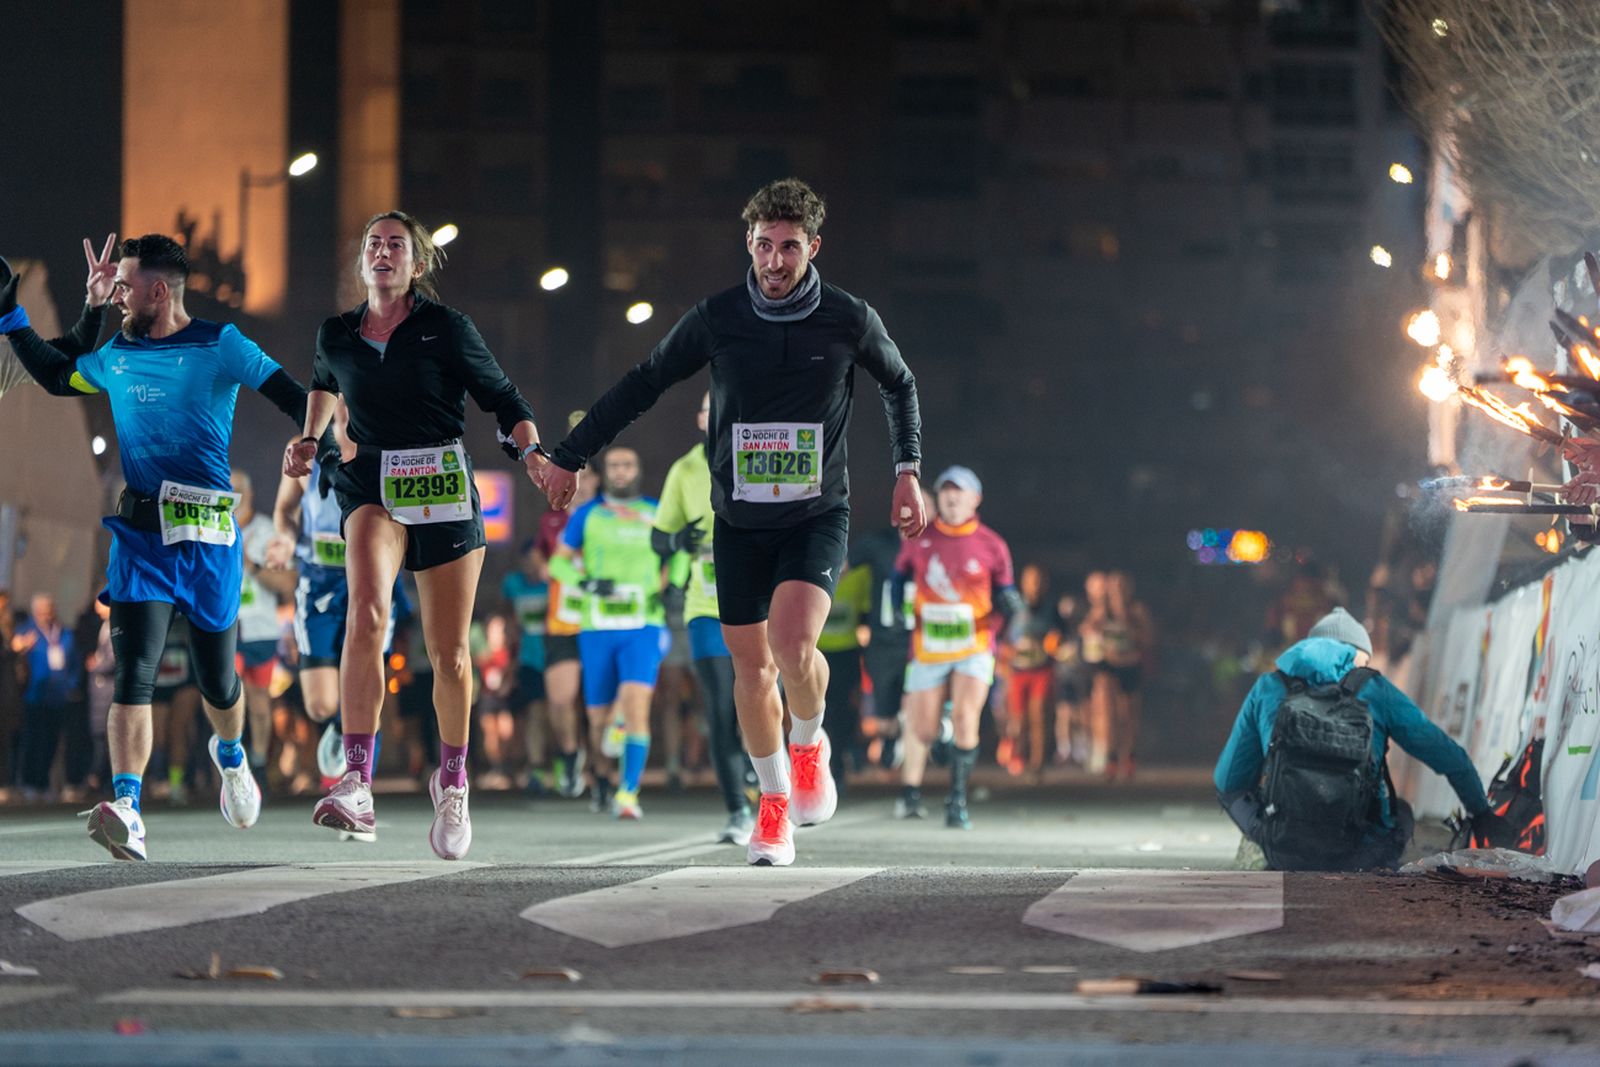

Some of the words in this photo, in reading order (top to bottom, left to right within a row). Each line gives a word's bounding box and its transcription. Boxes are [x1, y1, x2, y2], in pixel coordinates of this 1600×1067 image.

[752, 431, 777, 440] NOCHE
[779, 431, 790, 440] DE
[742, 442, 760, 451] SAN
[400, 456, 425, 466] NOCHE
[426, 456, 436, 464] DE
[744, 451, 811, 476] 13626
[390, 467, 407, 477] SAN
[391, 473, 459, 499] 12393
[178, 492, 201, 504] NOCHE
